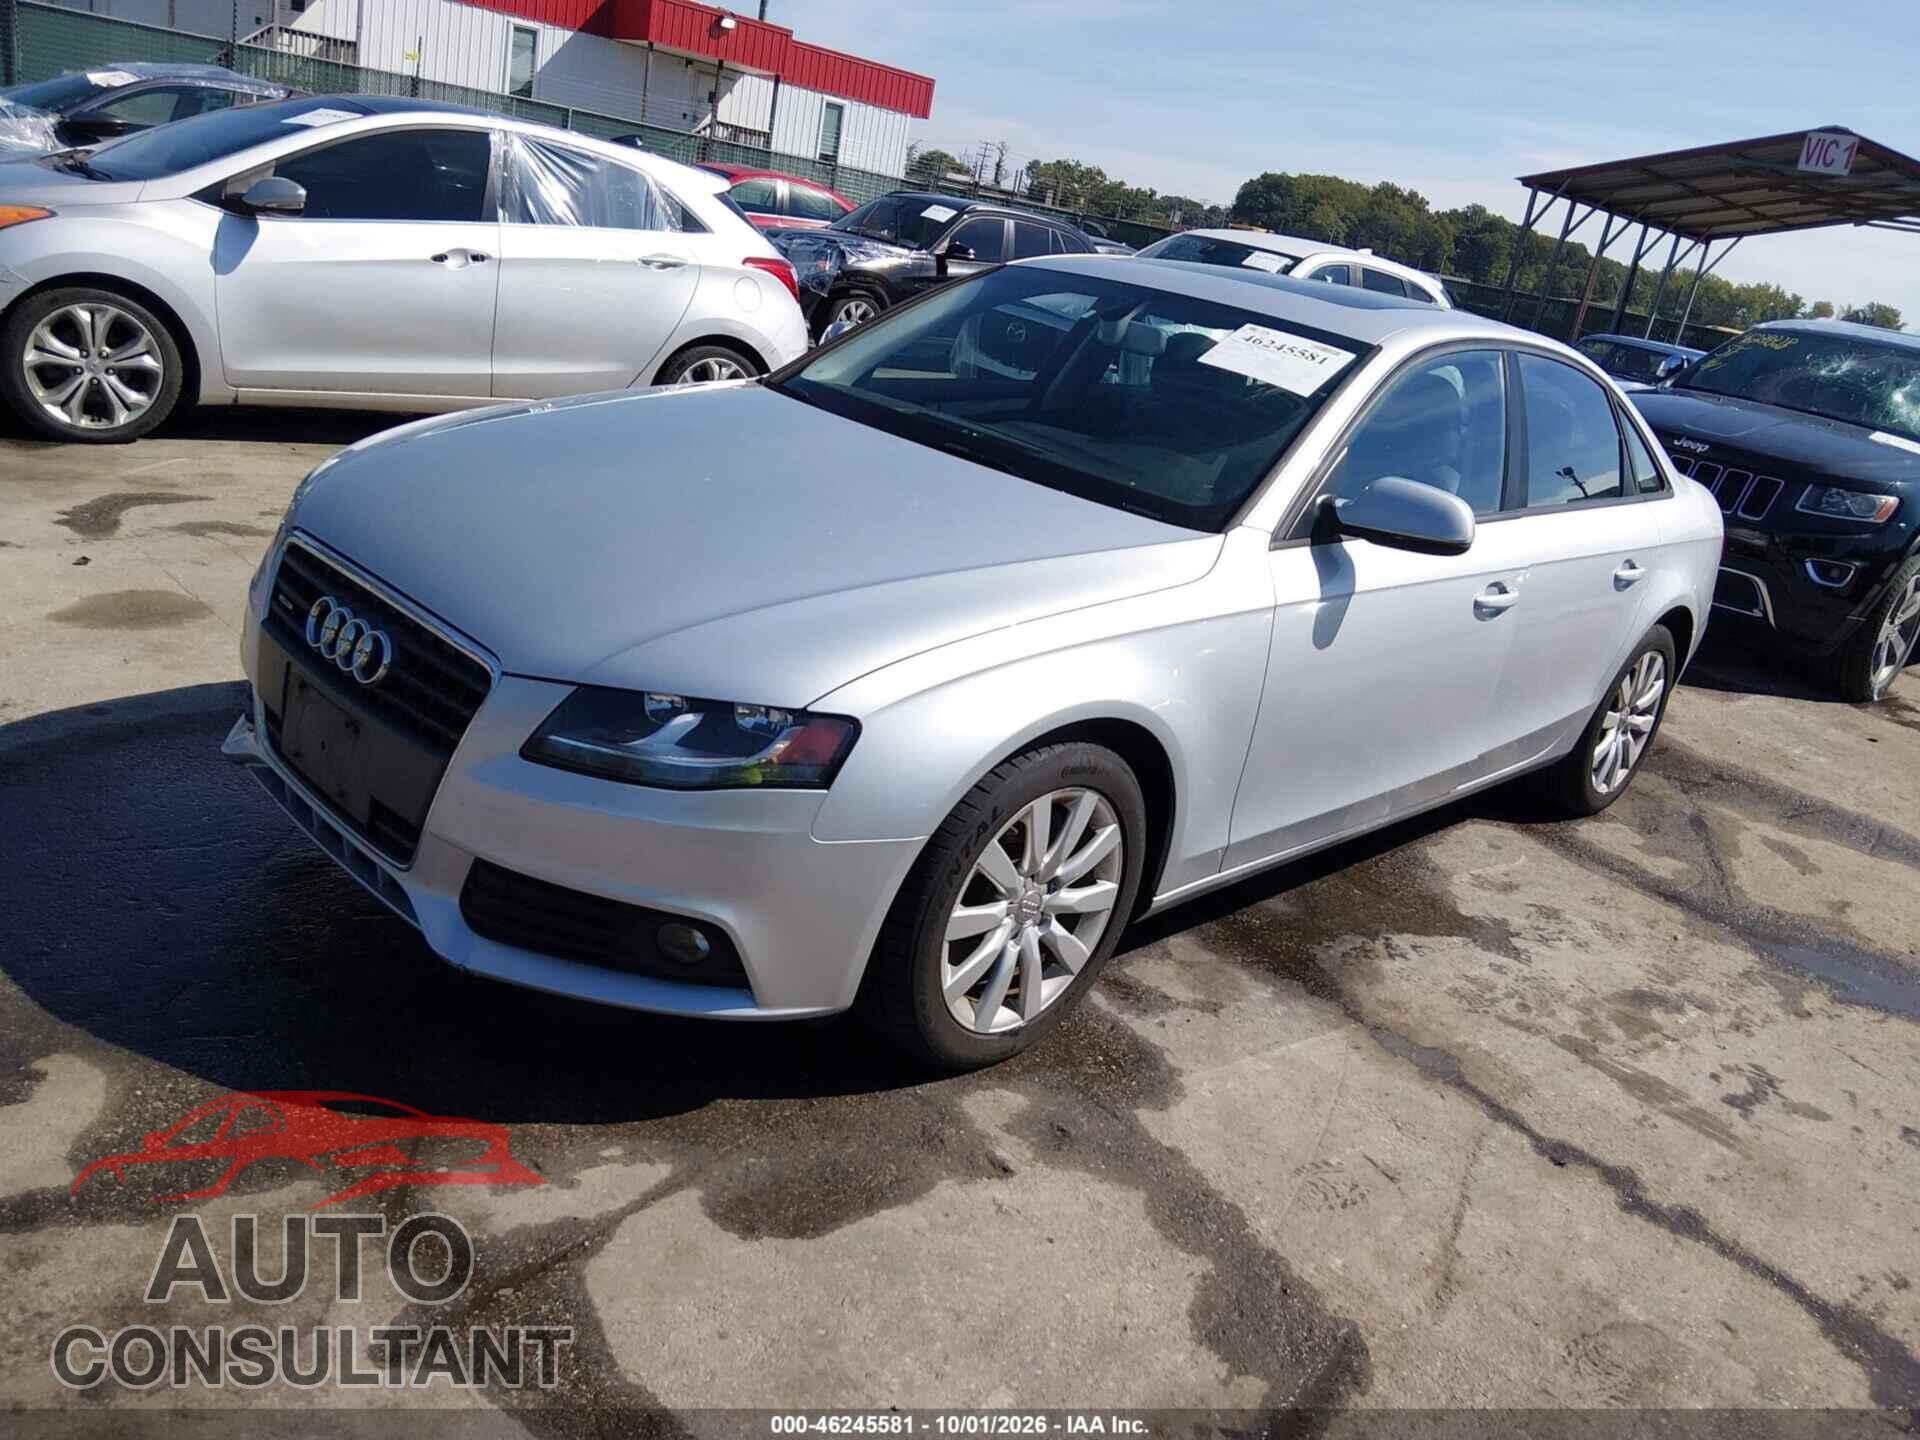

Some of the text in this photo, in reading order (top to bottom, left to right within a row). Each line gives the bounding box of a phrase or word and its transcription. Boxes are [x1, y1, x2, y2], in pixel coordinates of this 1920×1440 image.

[1805, 137, 1857, 170] VIC 1
[1243, 334, 1329, 366] 46245581
[1673, 436, 1710, 453] Jeep
